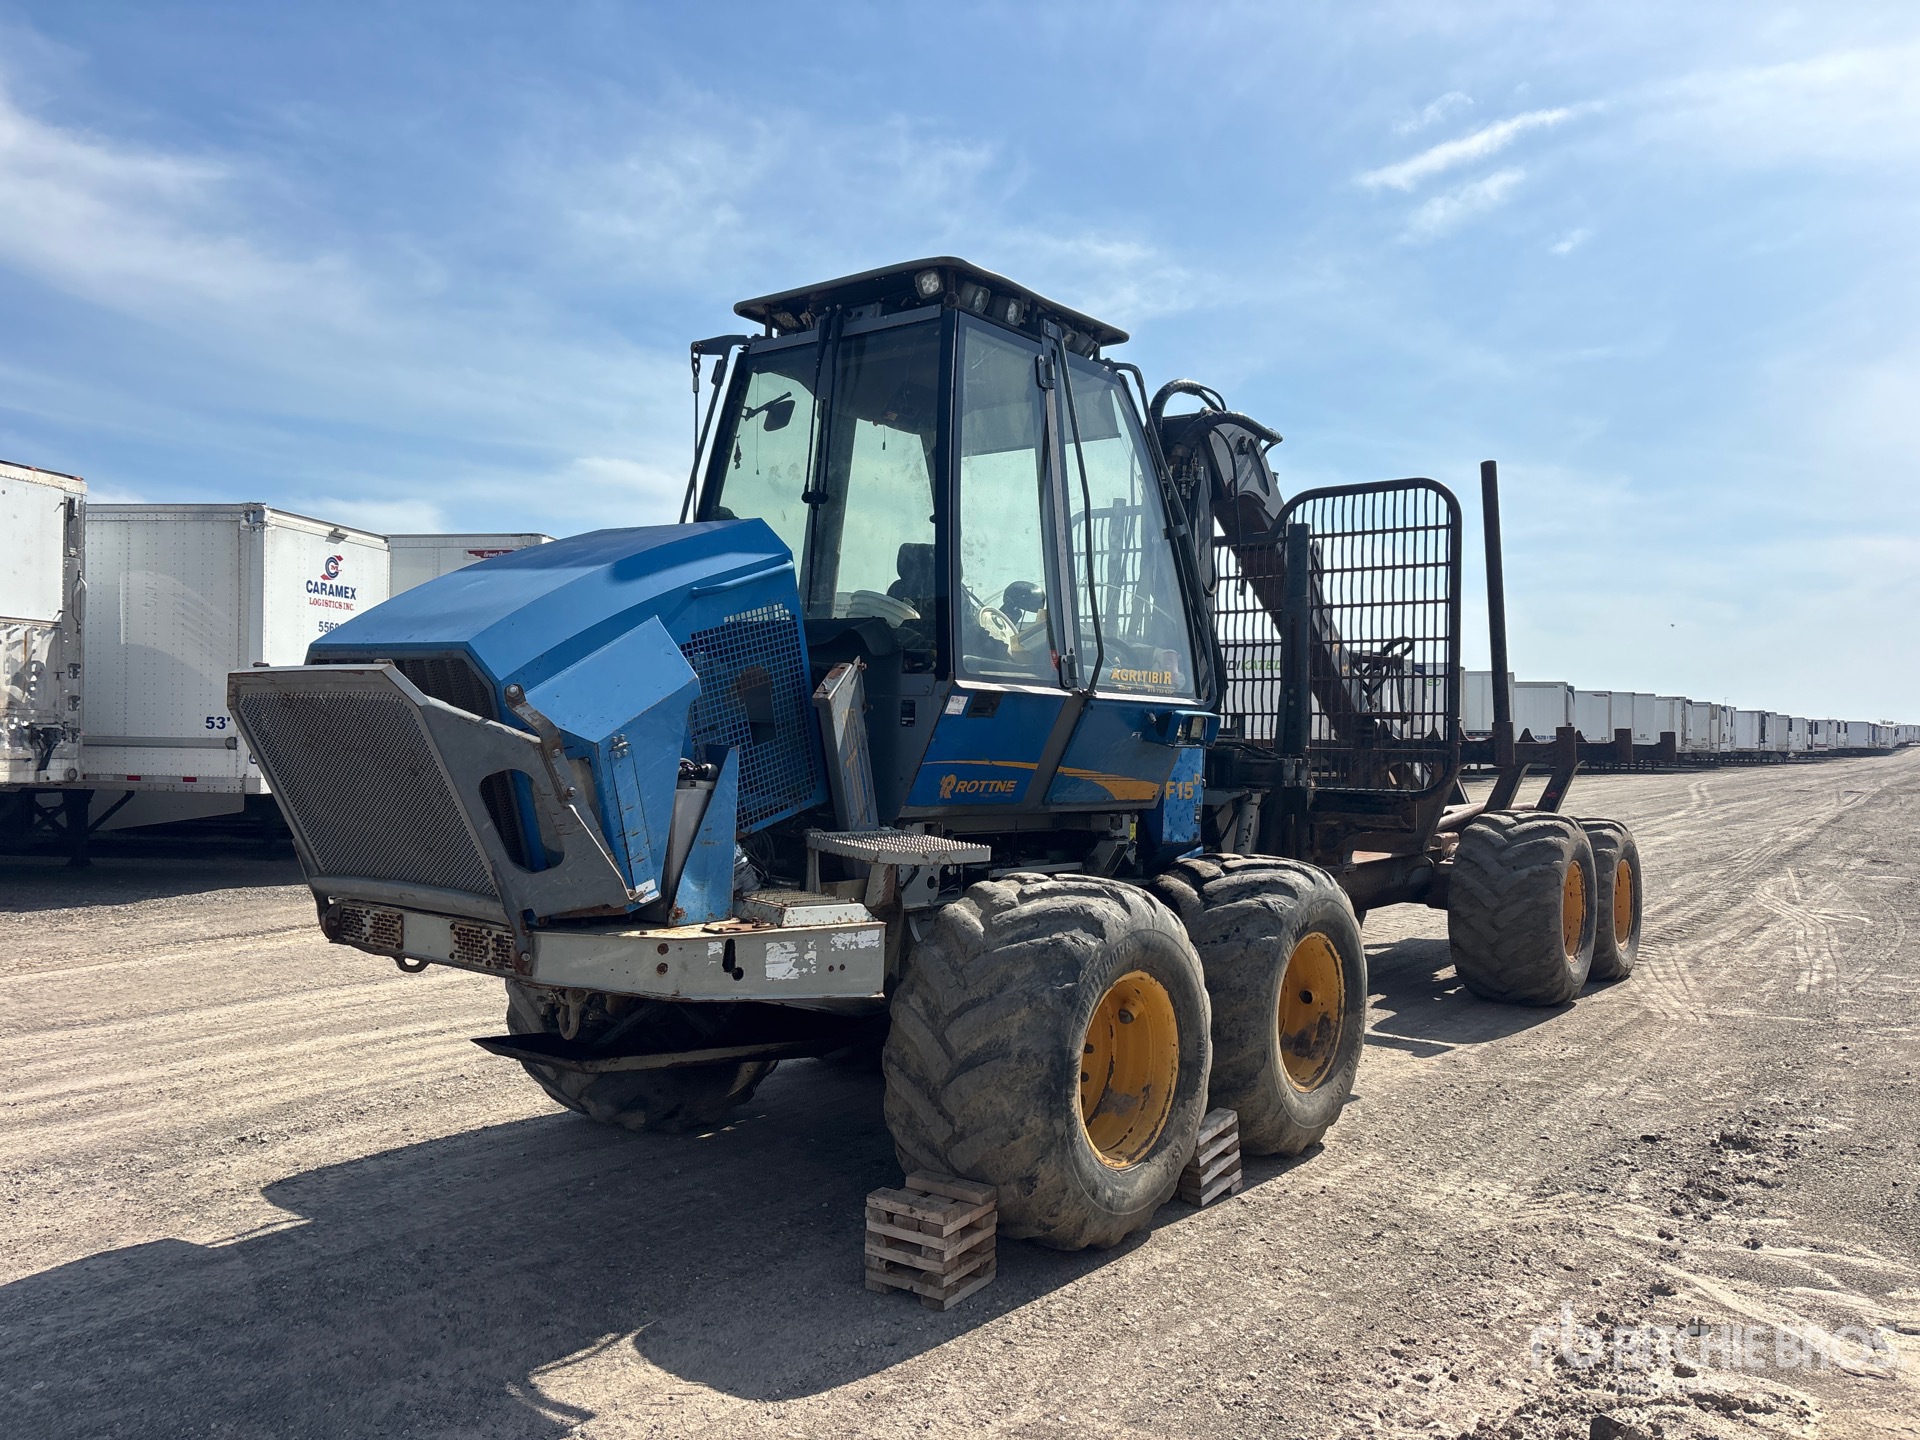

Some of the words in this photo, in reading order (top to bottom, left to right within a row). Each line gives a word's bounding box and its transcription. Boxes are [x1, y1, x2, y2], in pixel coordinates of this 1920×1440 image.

[306, 580, 357, 600] CARAMEX
[309, 597, 342, 609] LOGISTICS
[343, 602, 354, 611] INC.
[205, 716, 231, 730] 53'
[955, 780, 1017, 793] ROTTNE
